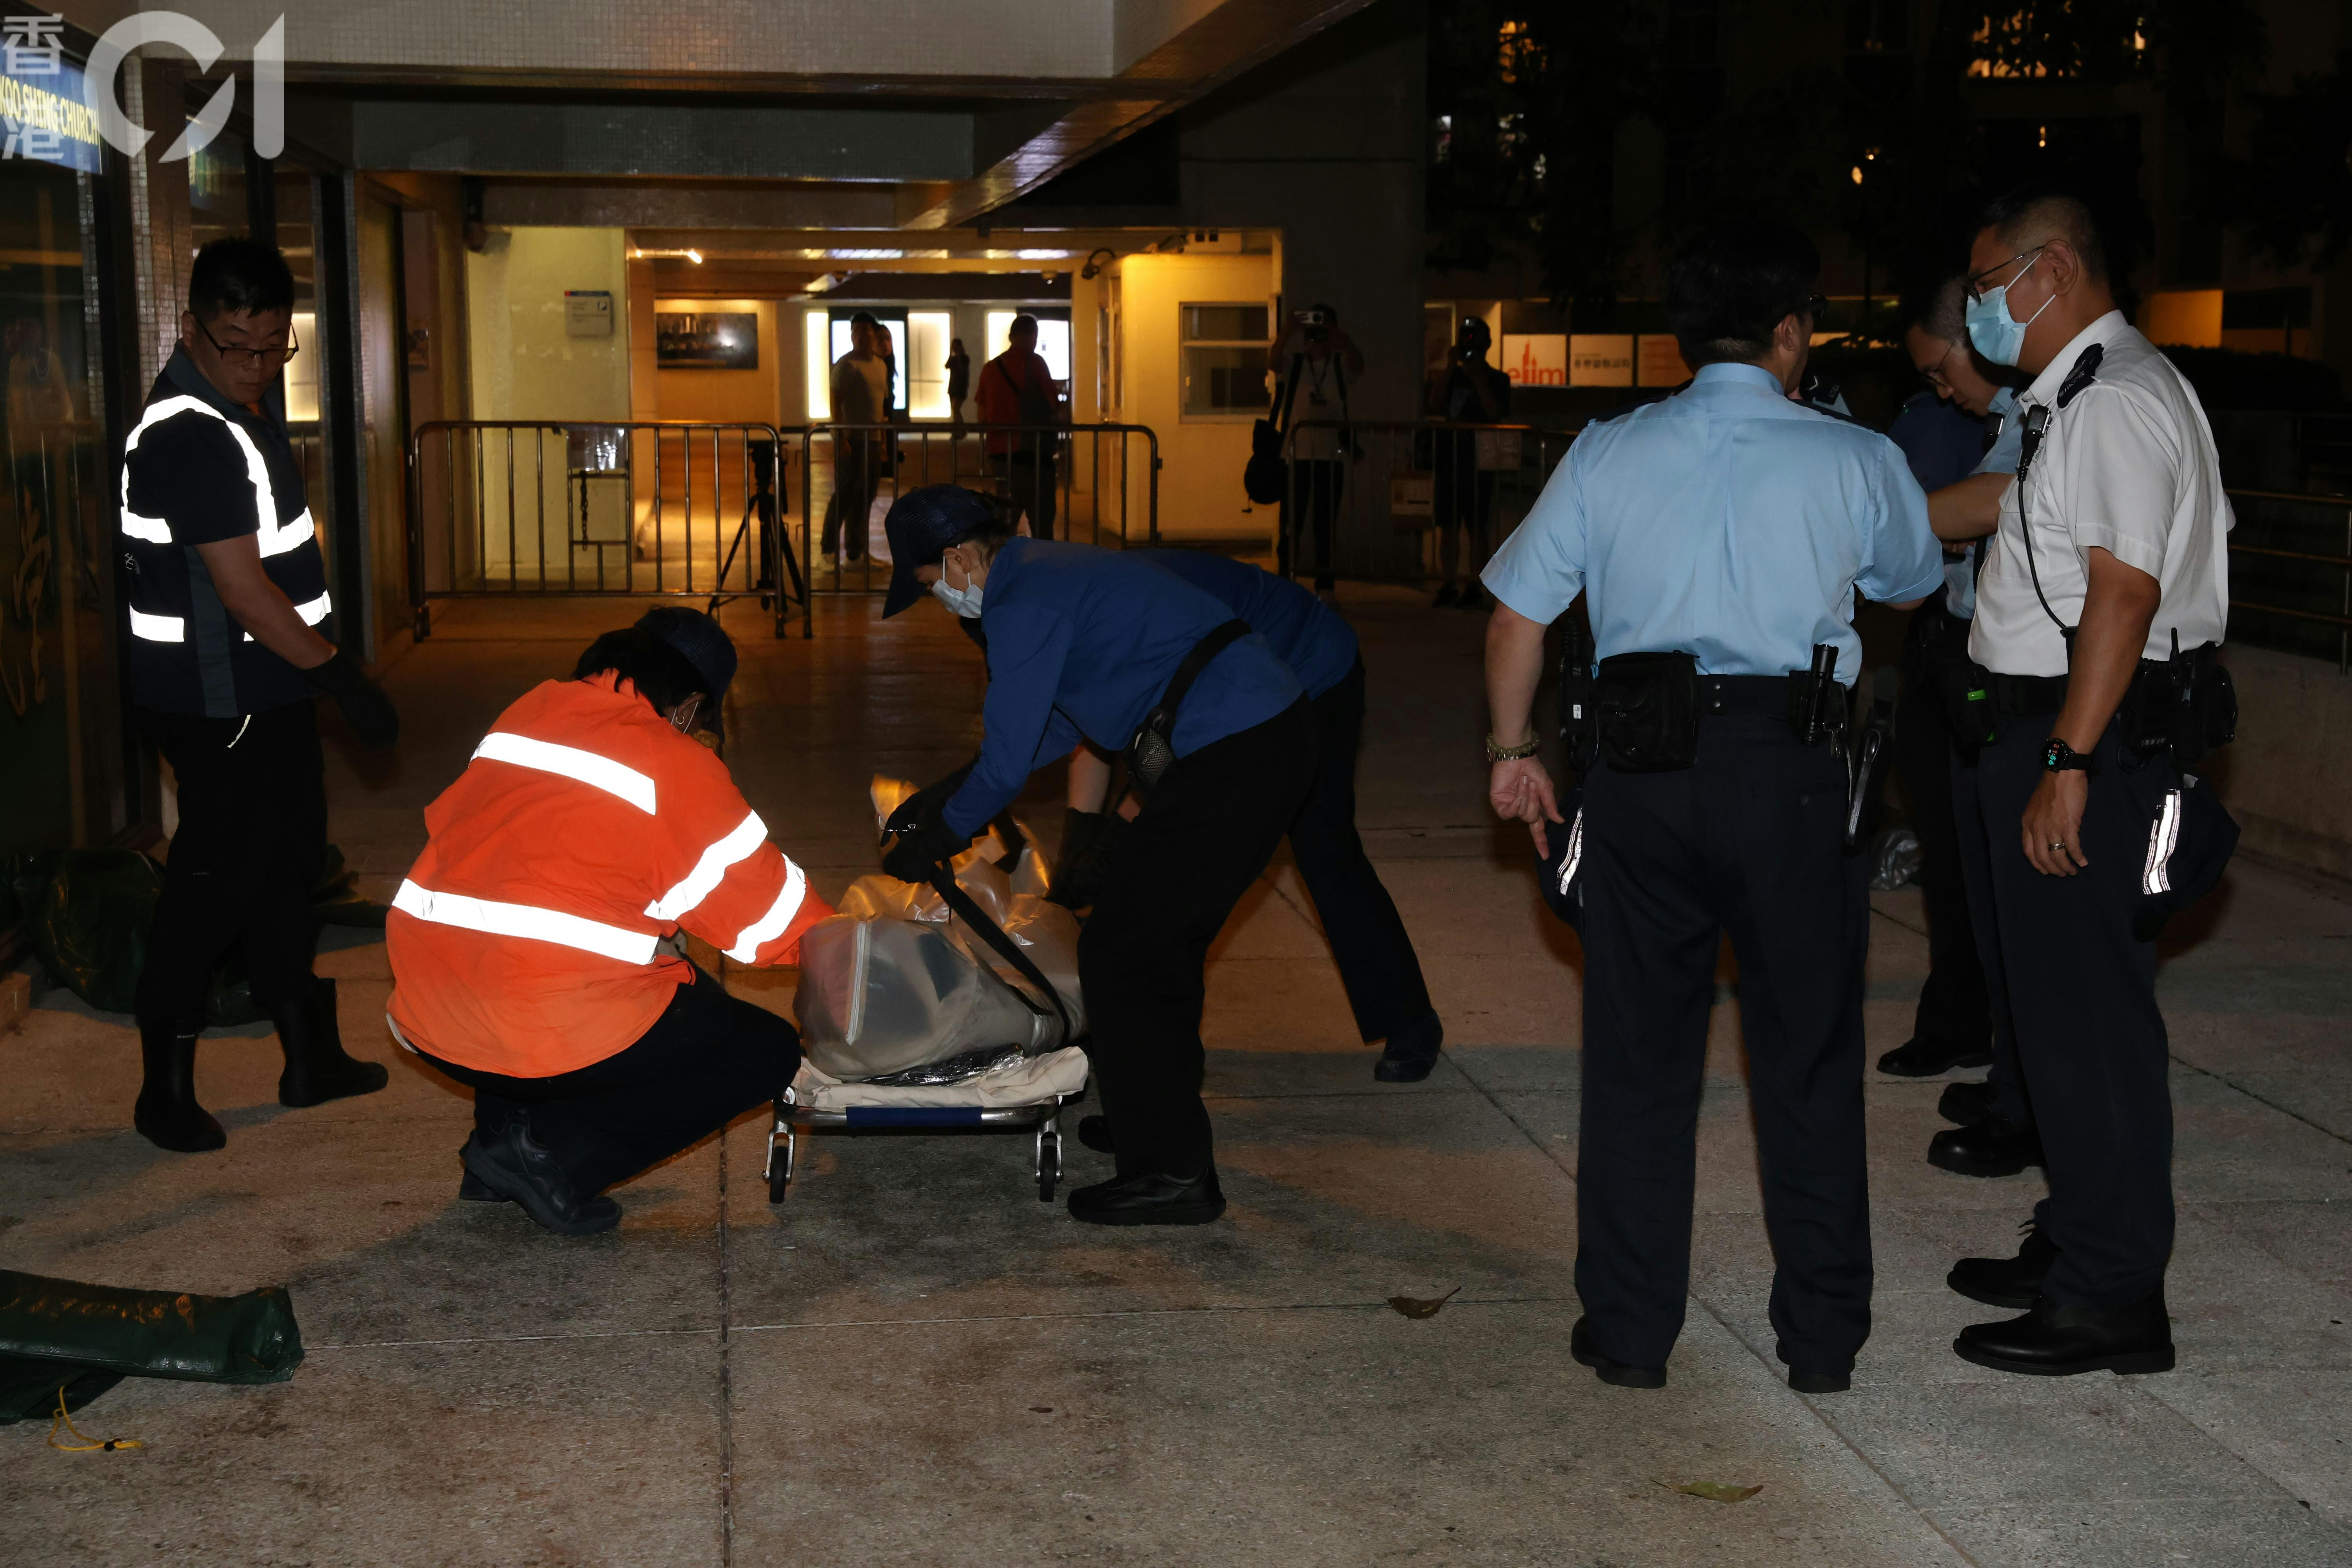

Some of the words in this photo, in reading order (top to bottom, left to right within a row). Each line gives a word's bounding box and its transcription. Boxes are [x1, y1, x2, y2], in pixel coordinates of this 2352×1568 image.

[23, 83, 58, 133] SHING
[60, 97, 98, 145] CHURCH
[2048, 743, 2059, 765] 21:56
